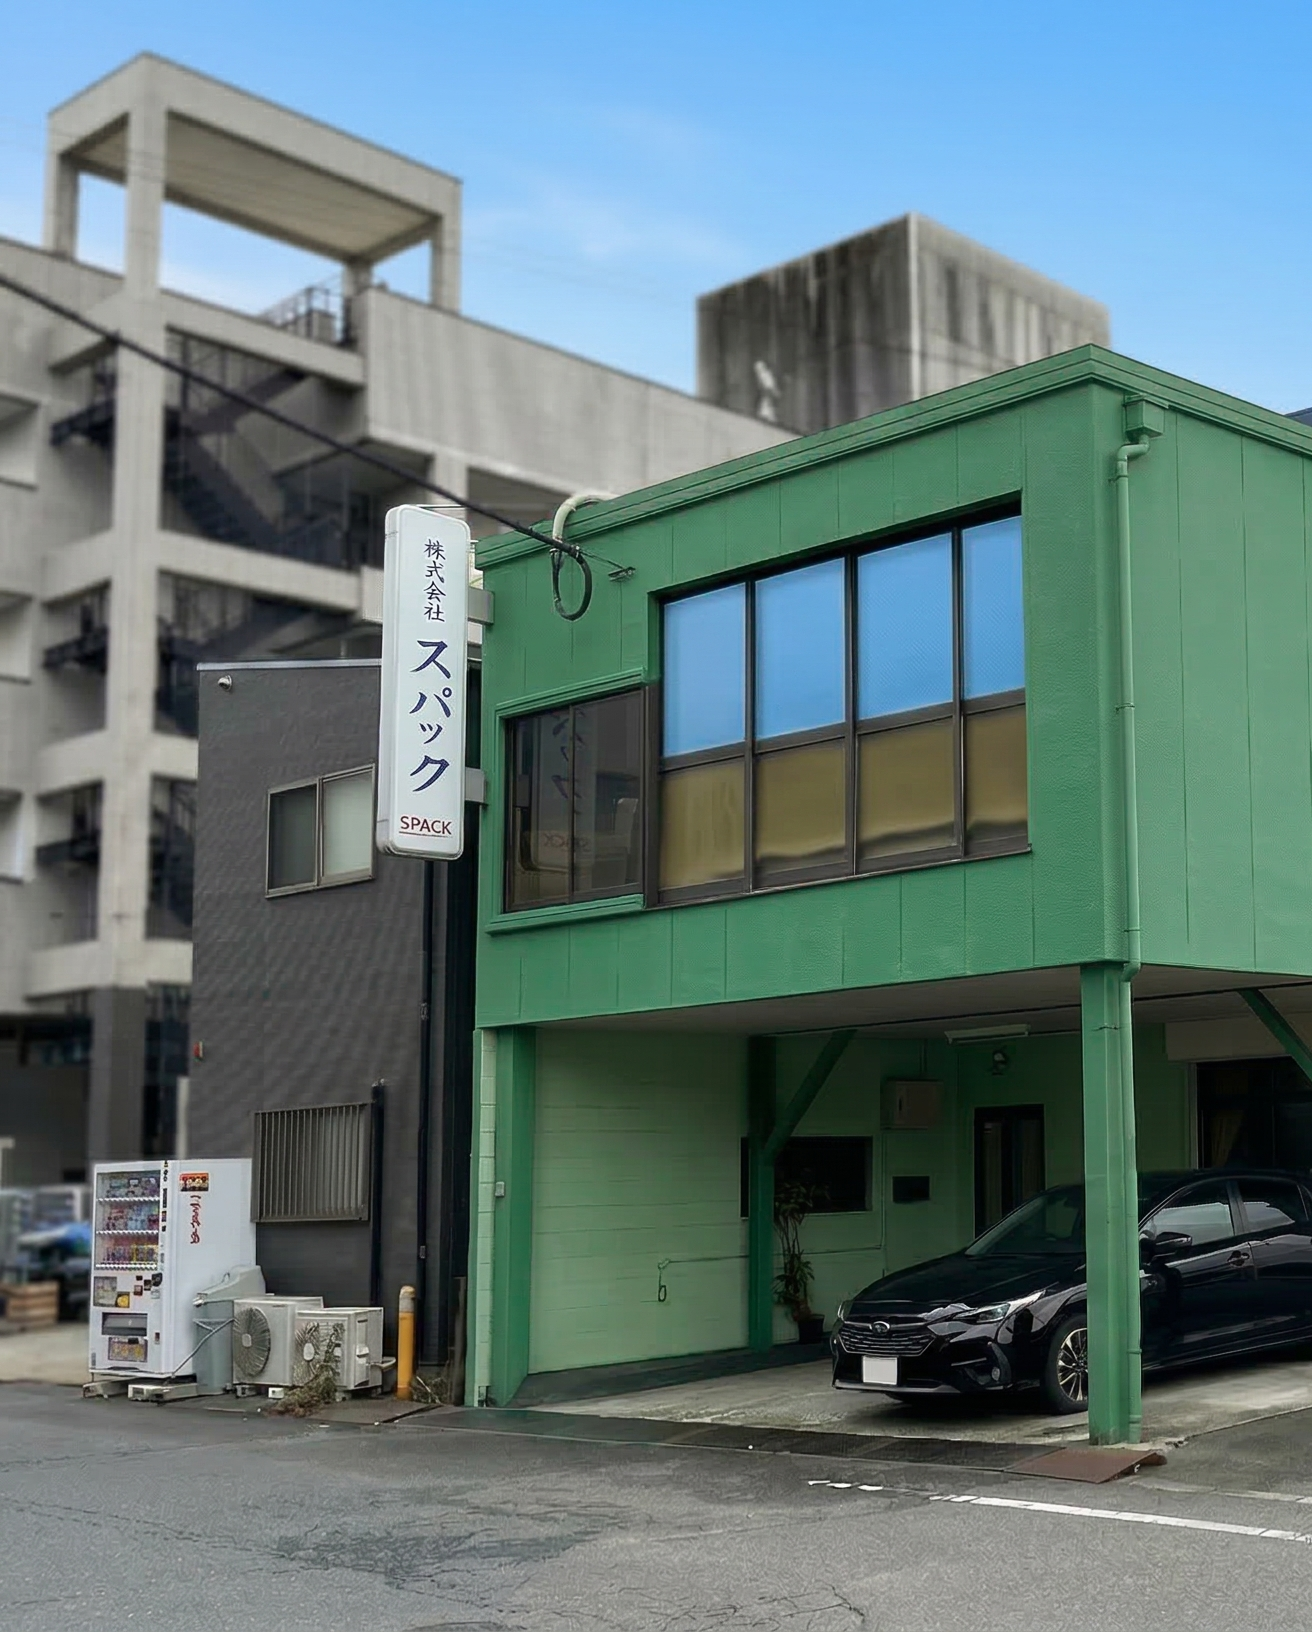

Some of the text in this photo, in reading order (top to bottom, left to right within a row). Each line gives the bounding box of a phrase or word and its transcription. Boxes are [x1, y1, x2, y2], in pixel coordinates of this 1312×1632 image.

[409, 538, 452, 792] 株式会社 スパック
[400, 815, 452, 835] SPACK
